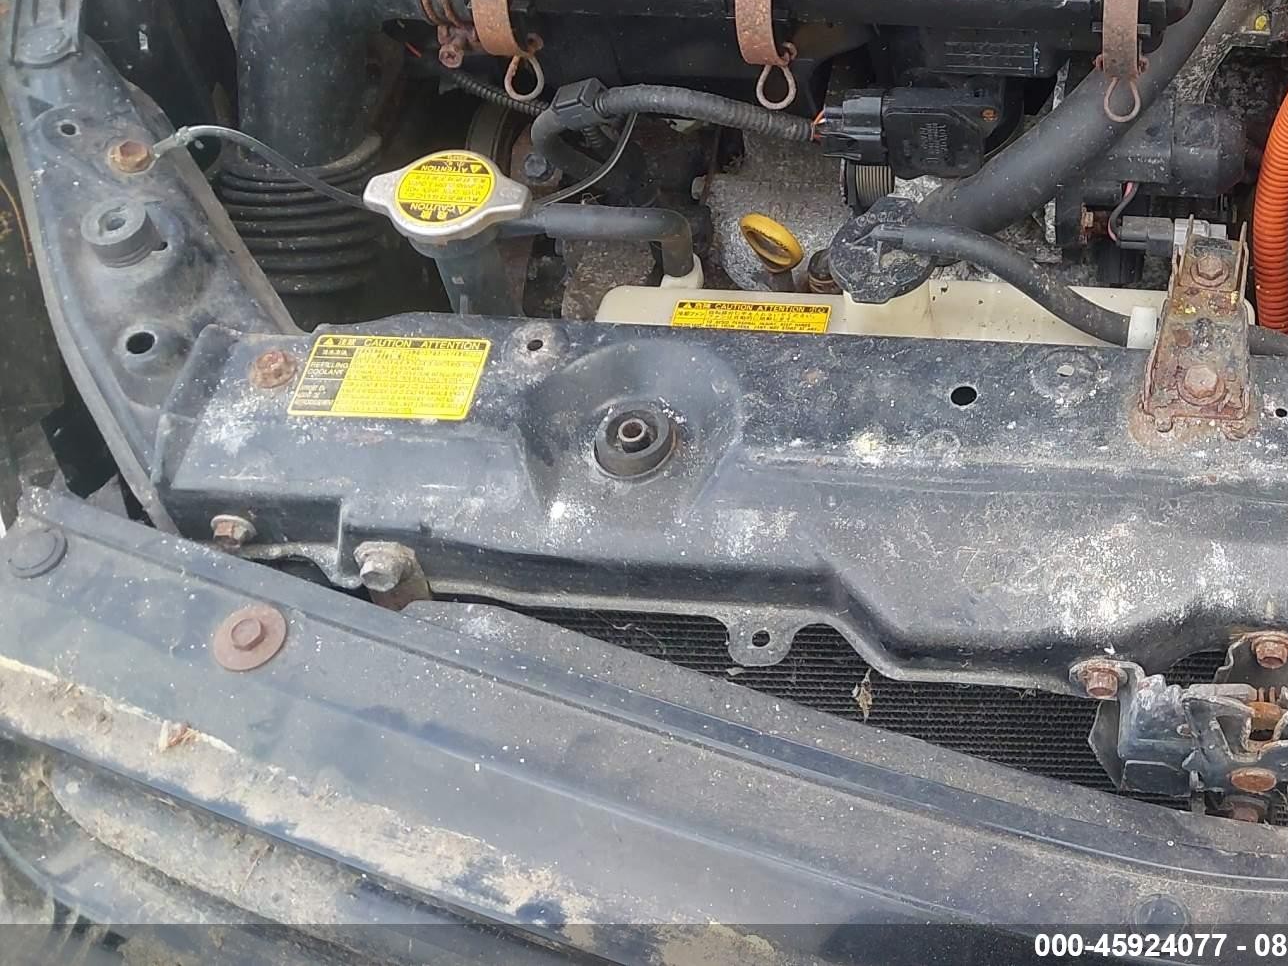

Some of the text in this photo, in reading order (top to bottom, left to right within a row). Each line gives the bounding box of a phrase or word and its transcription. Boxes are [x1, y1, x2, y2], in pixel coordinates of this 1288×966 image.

[410, 202, 456, 213] CAUTION
[714, 303, 753, 311] CAUTION
[758, 305, 805, 313] ATTENTION
[364, 338, 412, 348] CAUTION
[420, 340, 481, 350] ATTENTION
[310, 361, 349, 369] REFILLING
[307, 368, 344, 376] COOLANT
